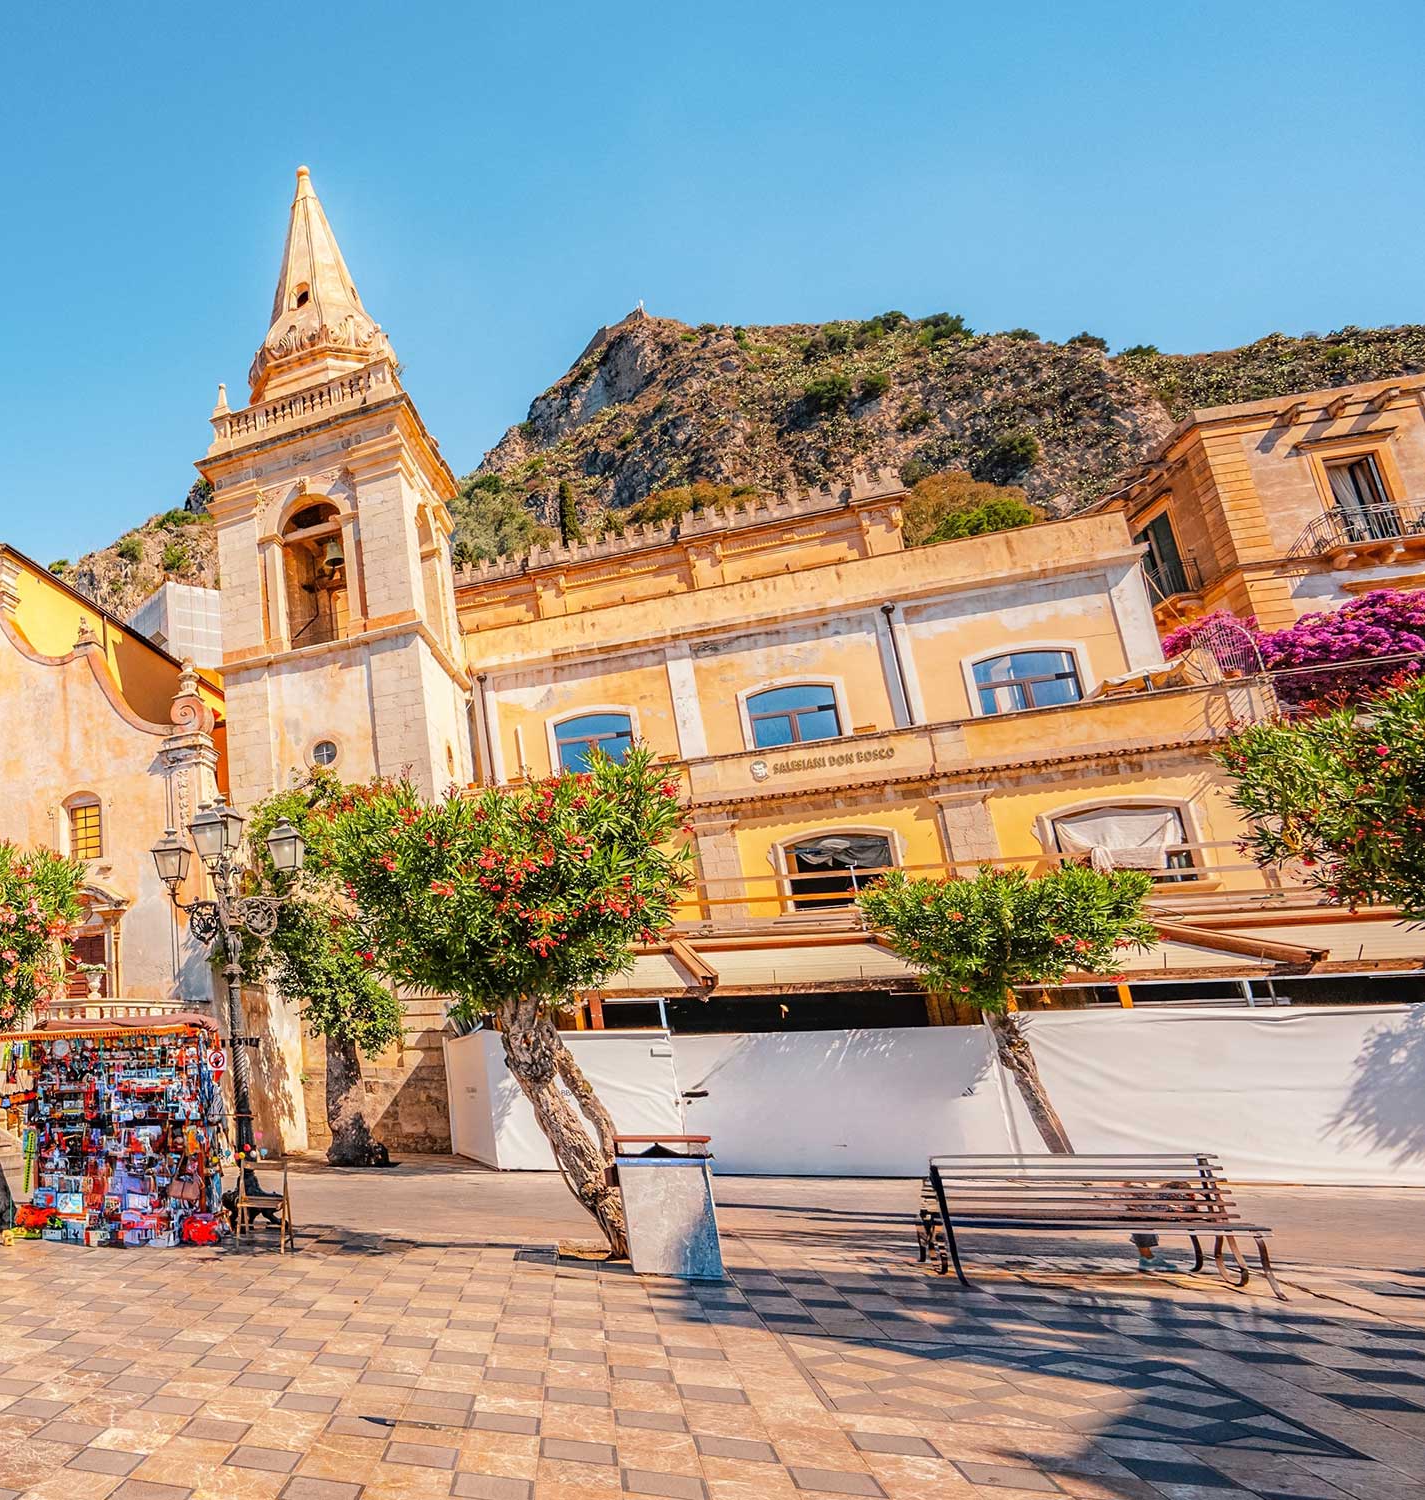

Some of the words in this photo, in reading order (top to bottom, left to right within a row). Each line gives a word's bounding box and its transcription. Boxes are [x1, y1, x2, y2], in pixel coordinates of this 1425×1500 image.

[773, 756, 826, 774] SALESIANI
[828, 753, 854, 767] DON
[856, 747, 895, 763] BOSCO
